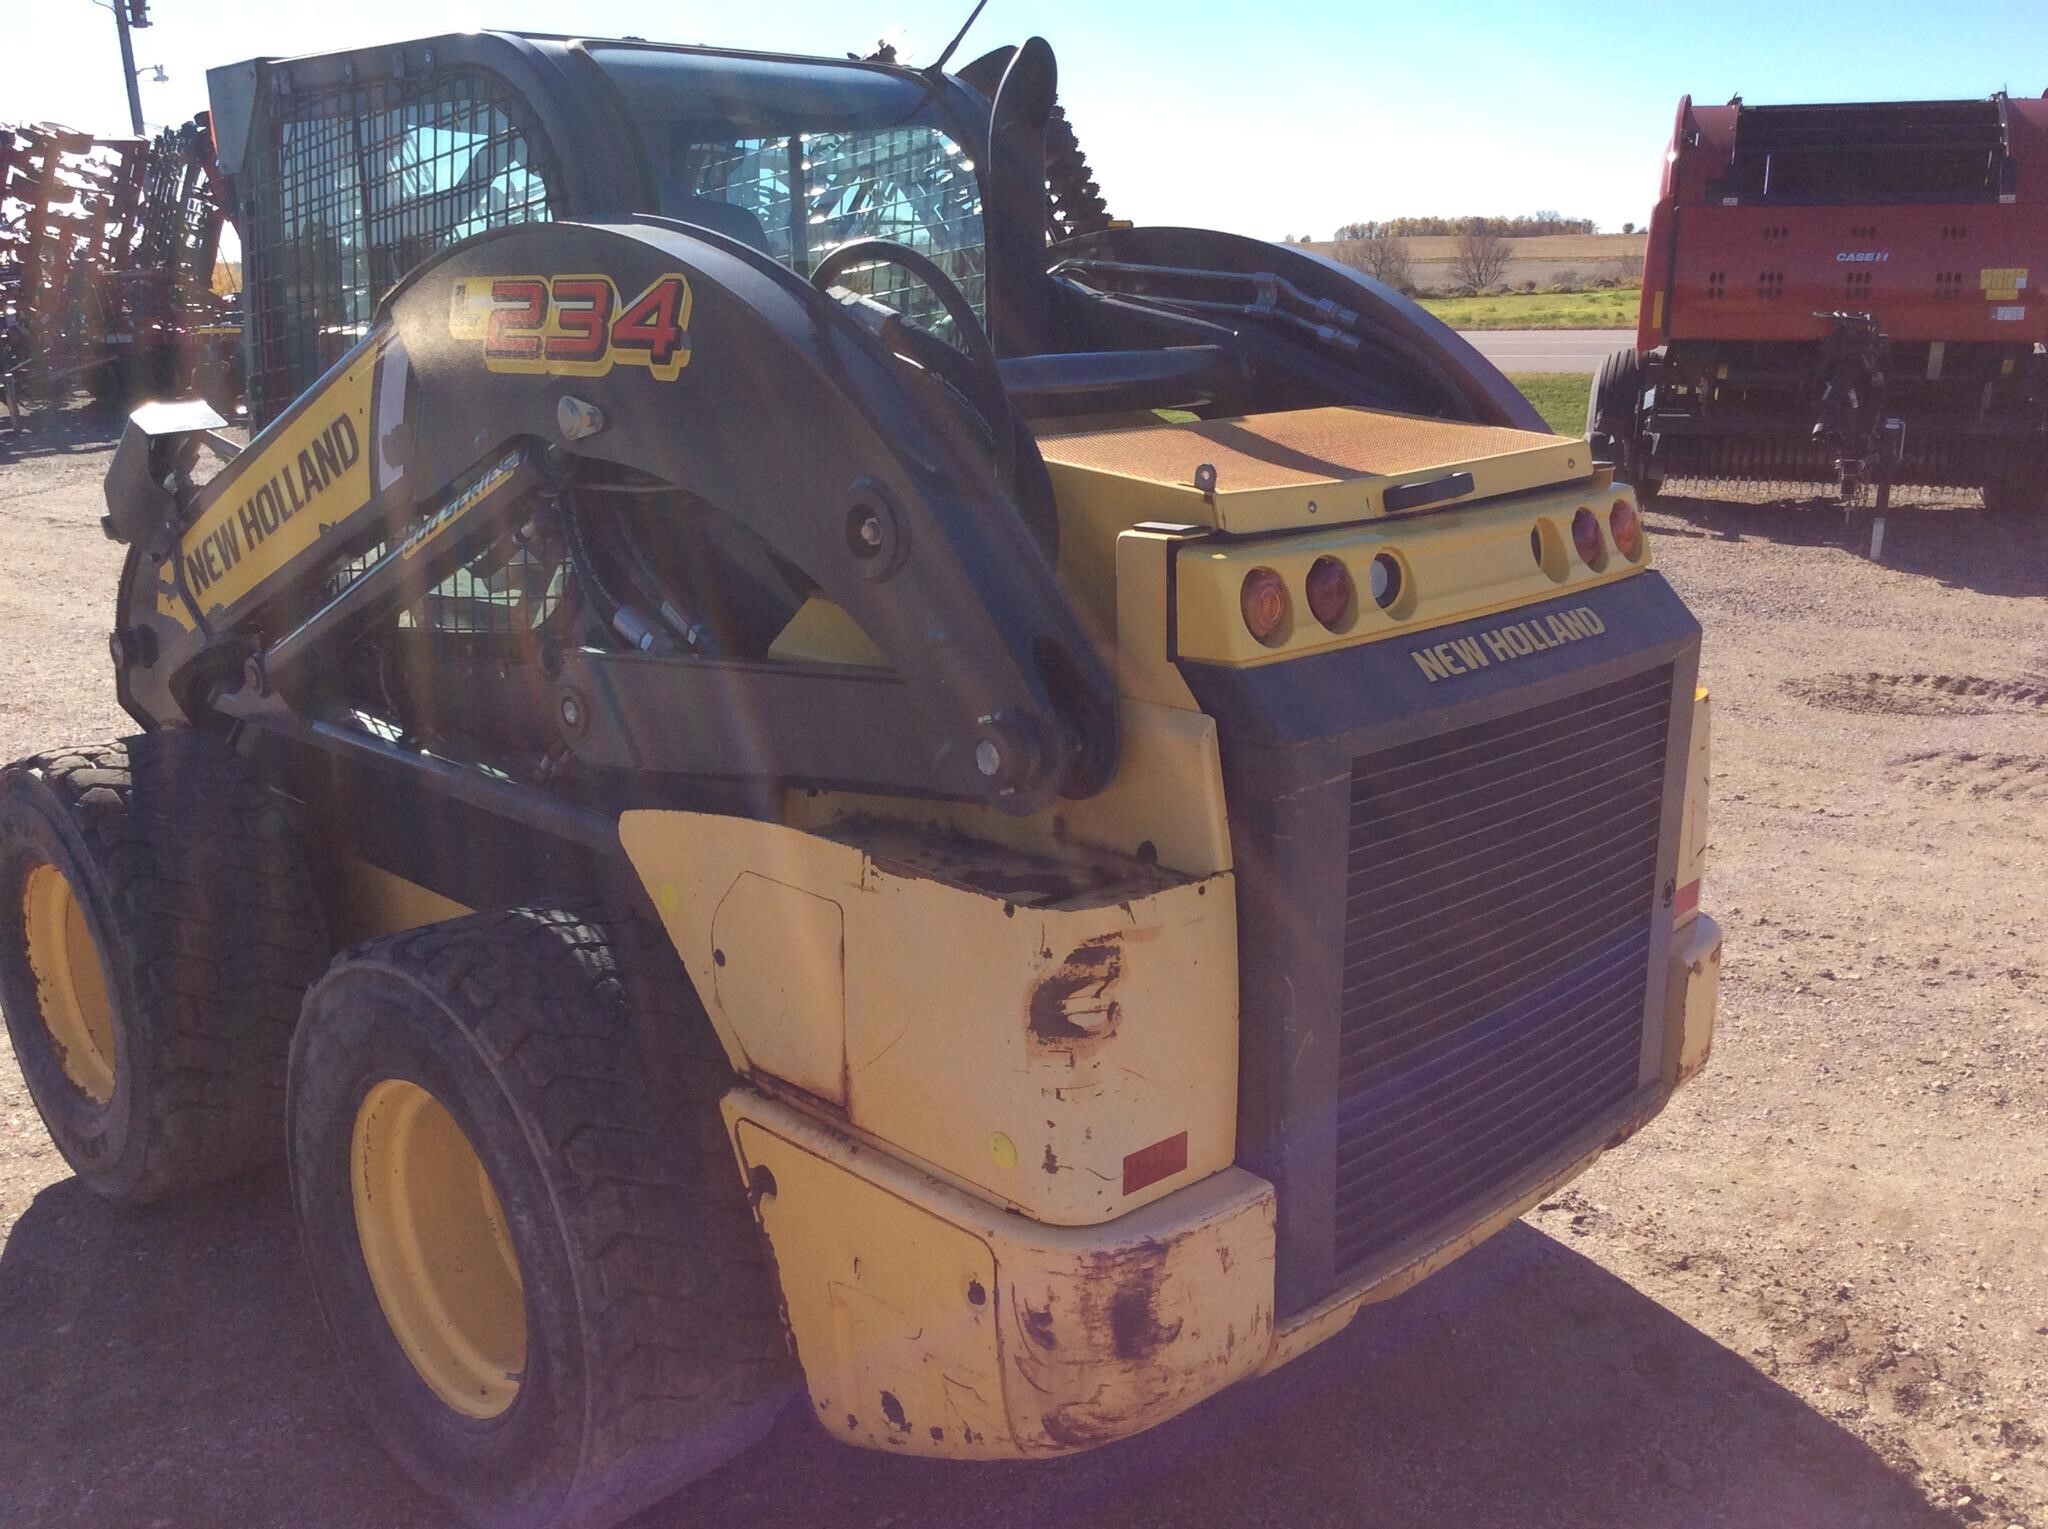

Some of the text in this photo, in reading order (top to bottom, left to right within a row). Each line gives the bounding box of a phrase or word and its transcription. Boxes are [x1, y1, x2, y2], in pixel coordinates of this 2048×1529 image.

[1836, 252, 1875, 262] CASE
[186, 413, 360, 597] NEW HOLLAND
[1410, 606, 1606, 683] NEW HOLLAND
